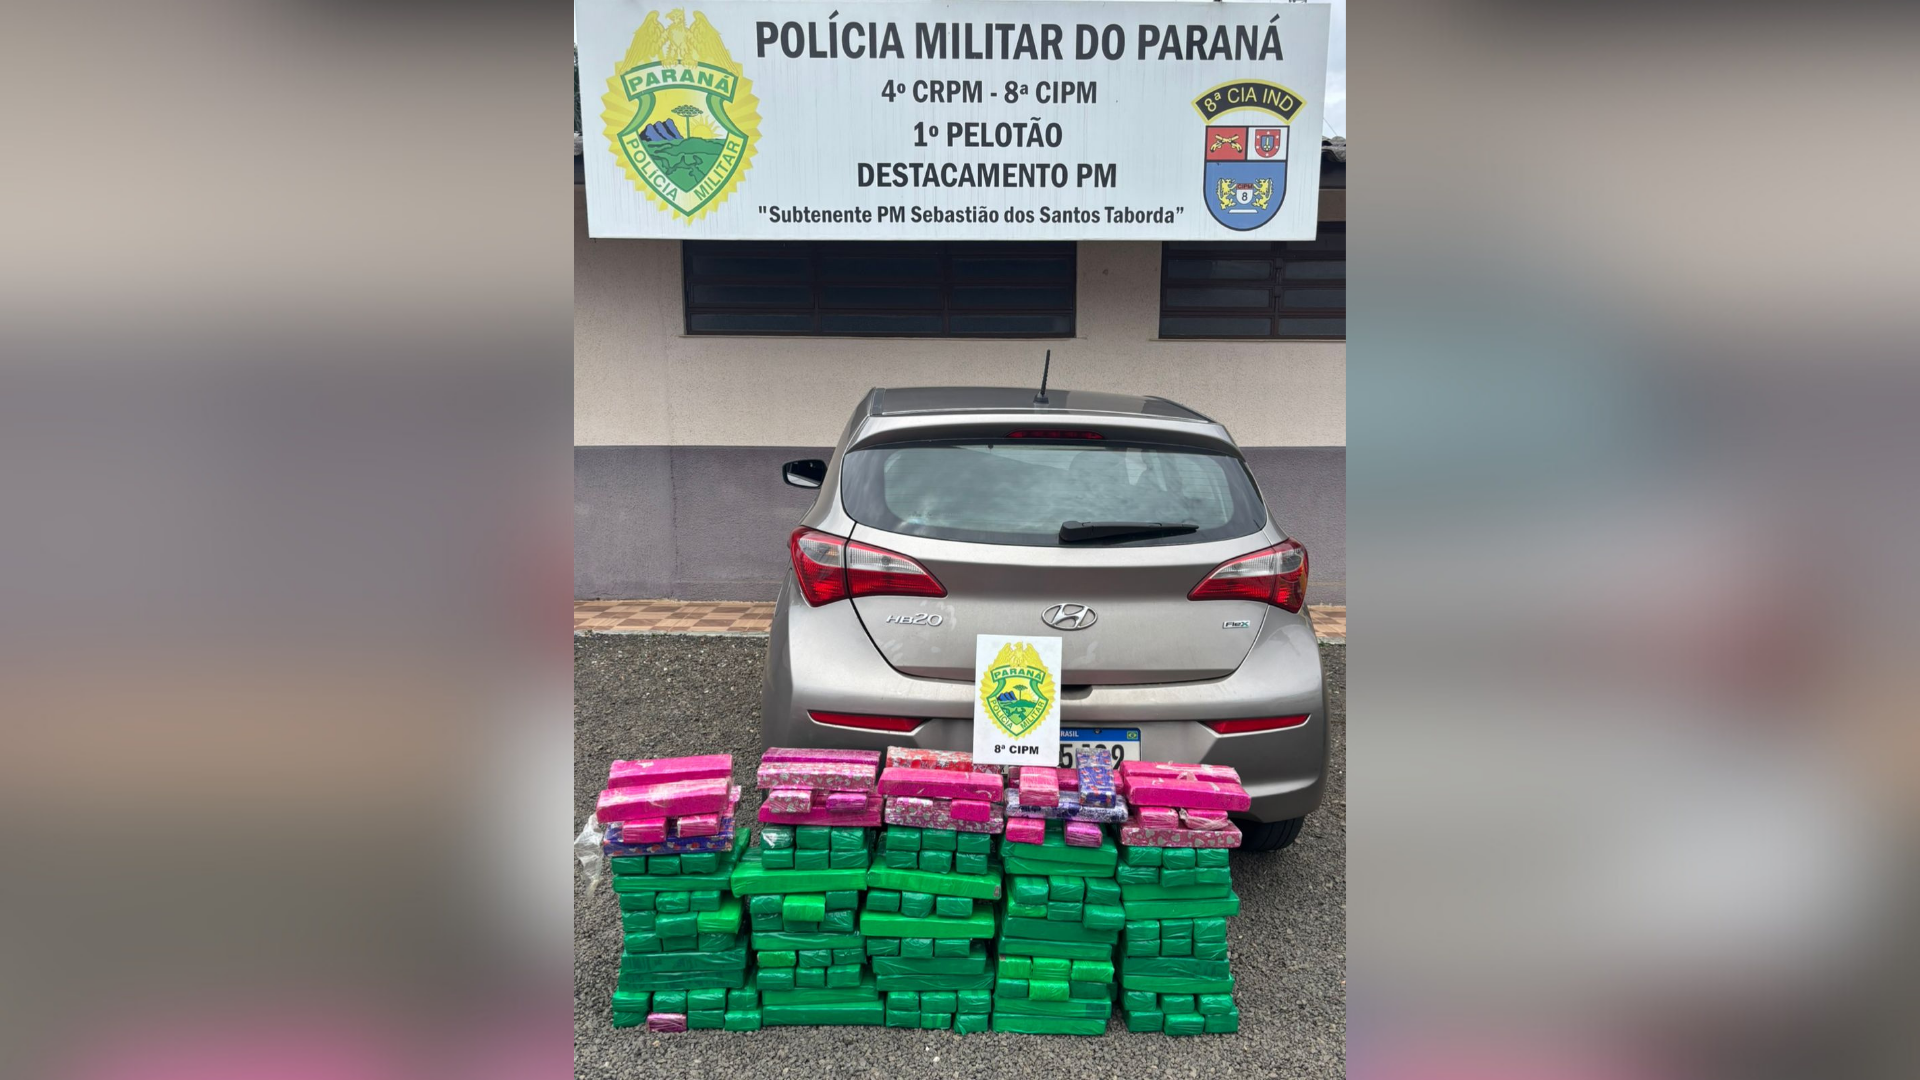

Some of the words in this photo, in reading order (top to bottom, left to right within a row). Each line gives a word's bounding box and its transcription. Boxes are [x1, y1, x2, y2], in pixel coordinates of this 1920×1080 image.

[755, 9, 905, 60] POLÍCIA
[915, 21, 1064, 61] MILITAR
[1075, 23, 1126, 61] DO
[1137, 13, 1284, 61] PARANÁ
[628, 68, 730, 94] PARANÁ
[912, 80, 983, 104] CRPM
[1035, 80, 1097, 104] CIPM
[1227, 86, 1257, 104] CIA
[1262, 88, 1293, 112] IND
[947, 116, 1063, 148] PELOTÃO
[626, 138, 678, 201] POLÍCIA
[693, 140, 740, 201] MILITAR
[857, 162, 1069, 188] DESTACAMENTO
[1076, 163, 1117, 188] PM
[1241, 191, 1248, 201] 8
[877, 206, 905, 224] PM
[910, 205, 999, 224] Sebastião
[1003, 205, 1035, 224] dos
[1039, 205, 1101, 224] Santos
[886, 612, 943, 627] HB20
[1020, 701, 1044, 730] MILITAR
[1060, 730, 1079, 738] RASIL
[1009, 745, 1039, 755] CIPM
